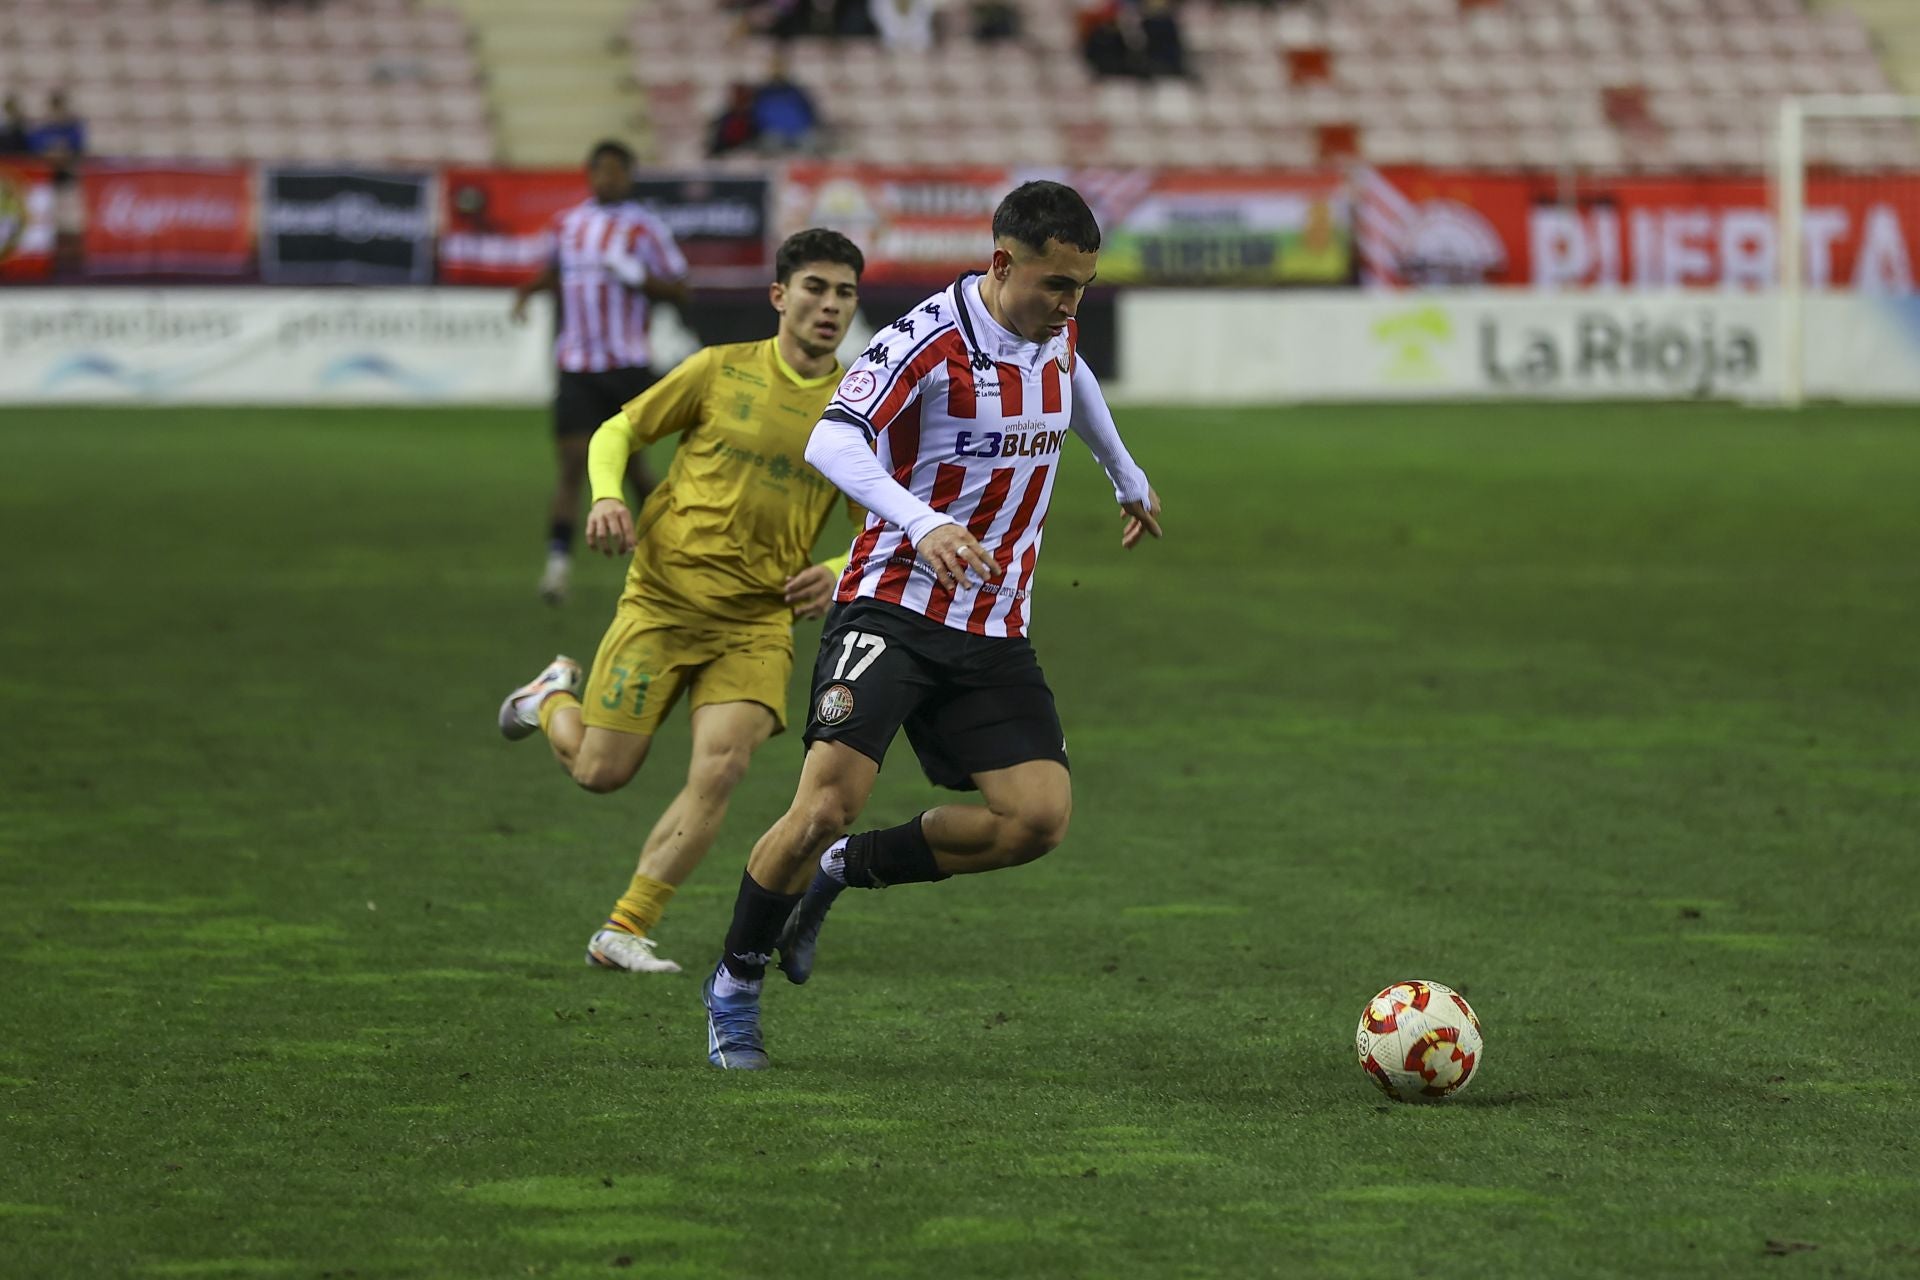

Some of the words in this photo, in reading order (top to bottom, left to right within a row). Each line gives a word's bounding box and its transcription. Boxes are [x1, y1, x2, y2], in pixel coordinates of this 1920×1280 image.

[1529, 204, 1915, 292] PUERTA
[1479, 310, 1562, 384] La
[1576, 310, 1760, 396] Rioja
[1005, 420, 1047, 433] embalajes
[832, 630, 887, 682] 17
[601, 666, 651, 716] 31
